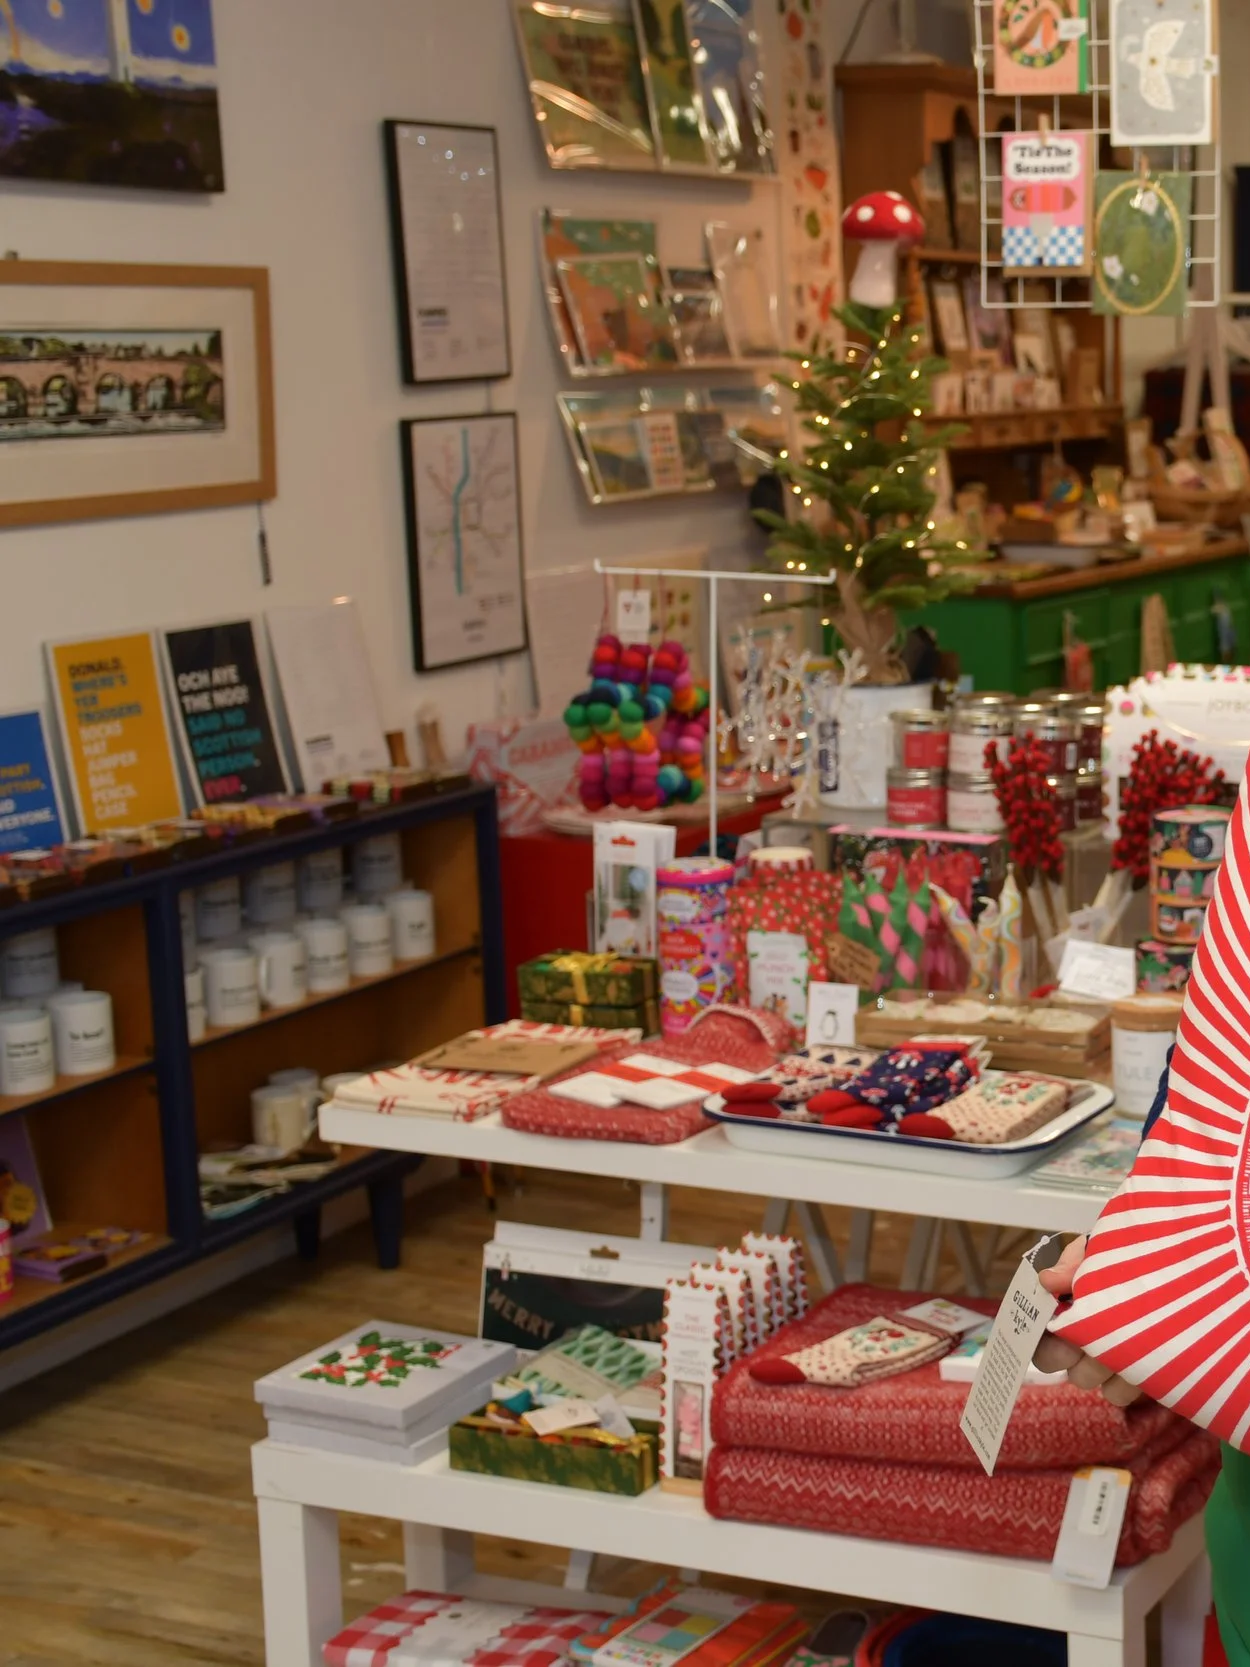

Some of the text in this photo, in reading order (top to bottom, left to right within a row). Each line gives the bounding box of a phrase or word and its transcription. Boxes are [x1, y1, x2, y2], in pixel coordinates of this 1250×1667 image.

[178, 664, 239, 692] OCH AYE
[182, 692, 213, 713] THE
[487, 1288, 555, 1340] MERRY
